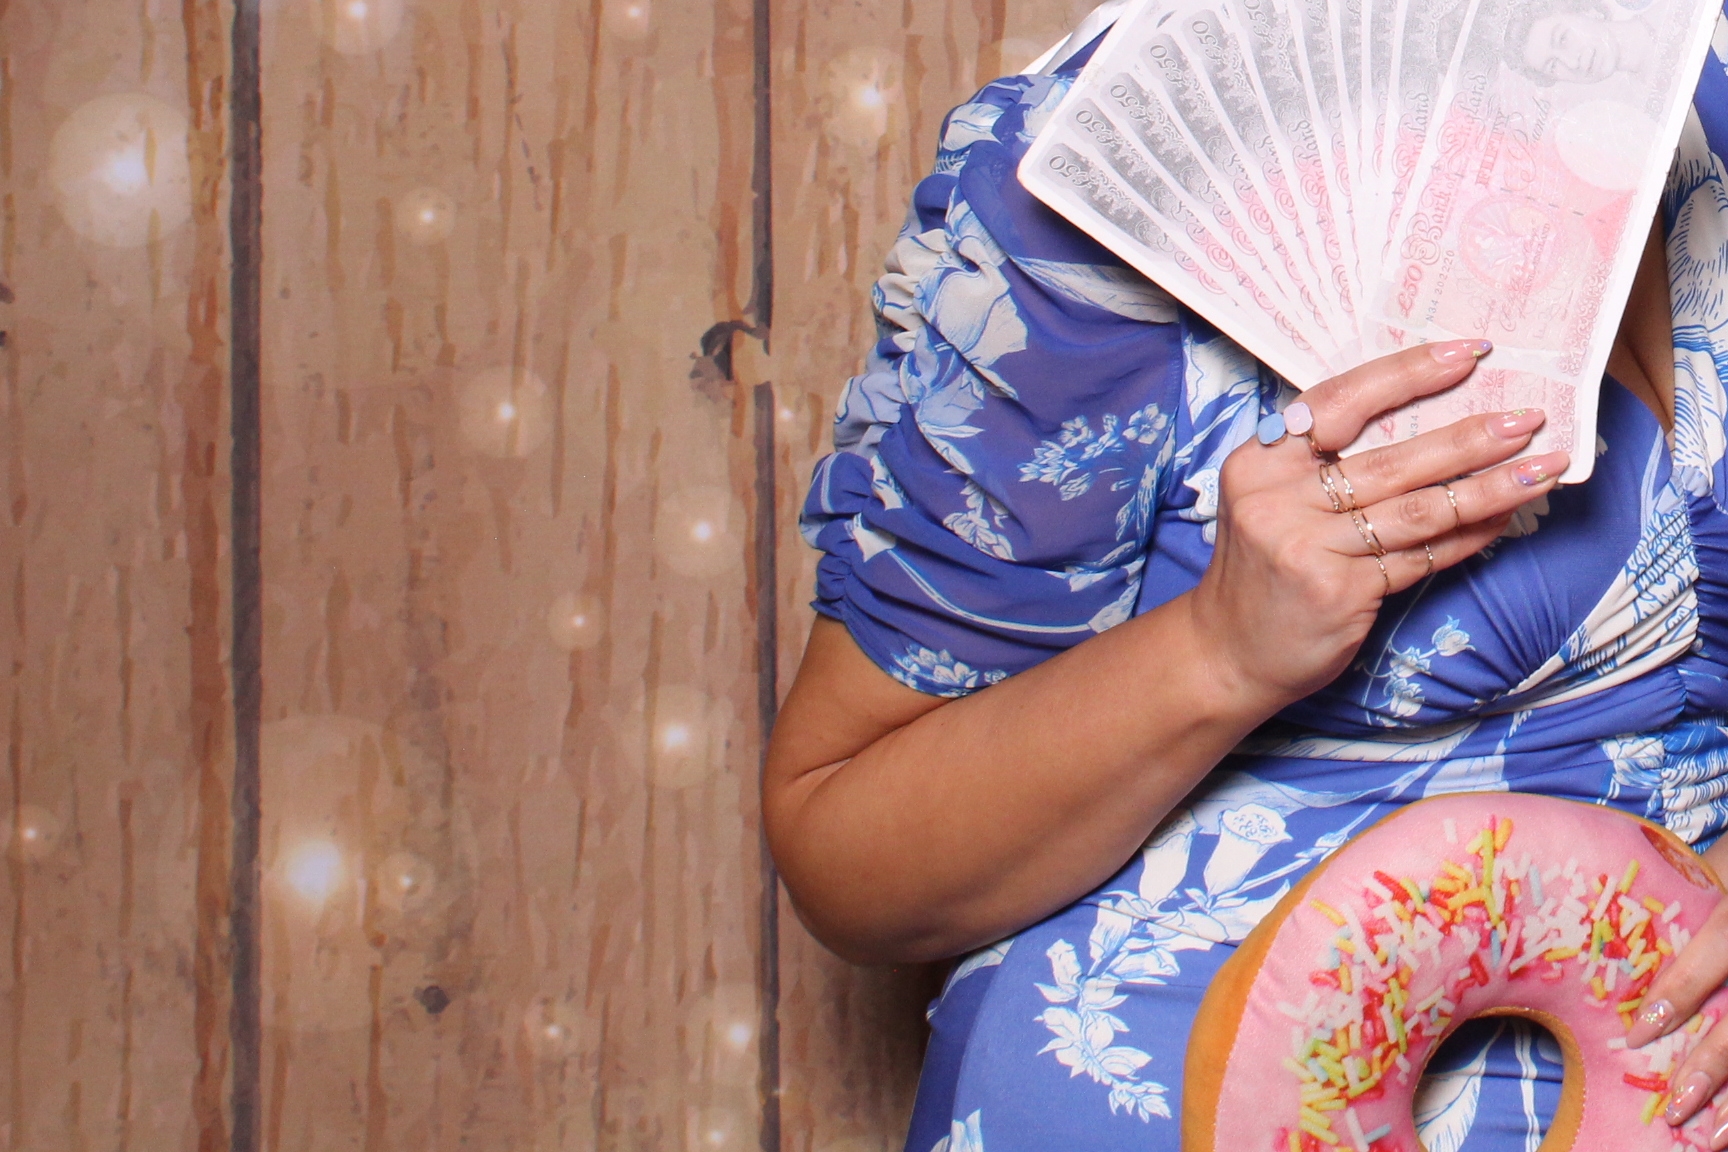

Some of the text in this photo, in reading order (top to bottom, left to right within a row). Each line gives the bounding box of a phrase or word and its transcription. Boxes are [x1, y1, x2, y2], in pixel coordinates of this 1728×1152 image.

[1191, 20, 1225, 64] £50
[1149, 43, 1185, 87] £50
[1110, 84, 1150, 122] £50
[1075, 109, 1118, 146] £50
[1475, 109, 1507, 186] FIFTY
[1502, 96, 1552, 192] Pounds
[1048, 154, 1095, 189] £50
[1398, 263, 1424, 318] £50
[1426, 249, 1454, 322] N34 202220
